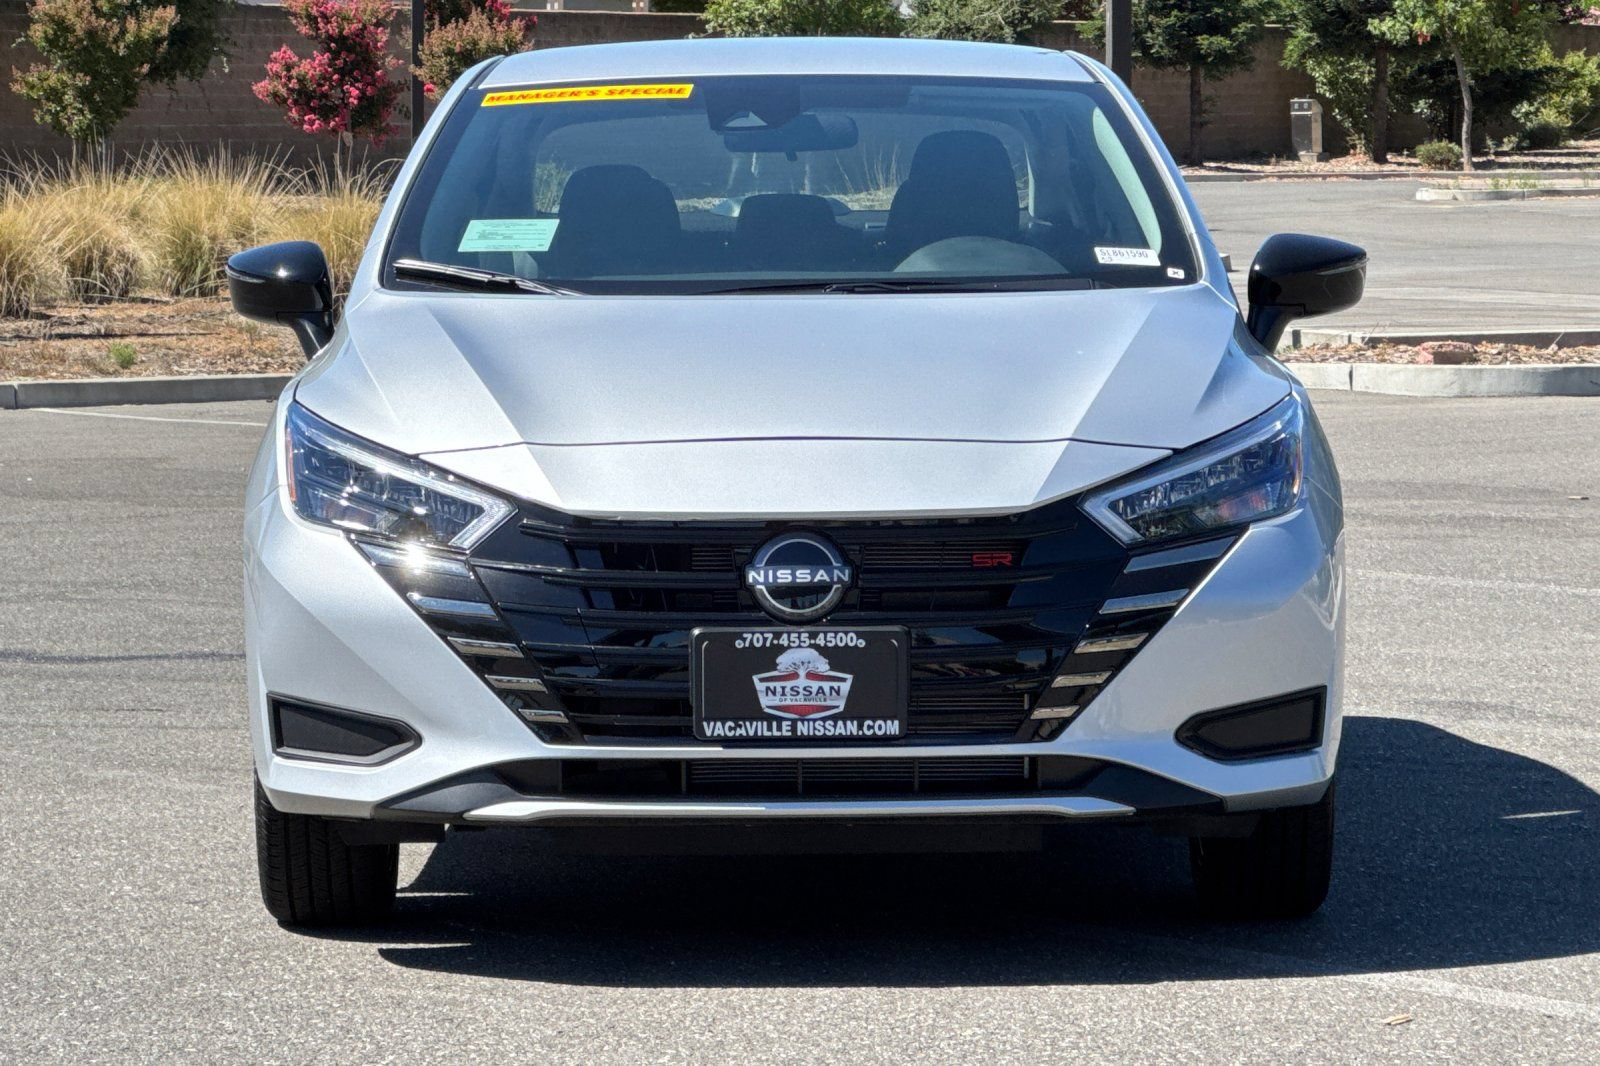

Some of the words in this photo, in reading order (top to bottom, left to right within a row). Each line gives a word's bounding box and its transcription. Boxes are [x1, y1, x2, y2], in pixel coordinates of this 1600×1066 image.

[486, 89, 600, 102] MANAGER'S
[604, 86, 687, 97] SPECIAL
[972, 552, 1012, 566] SR
[748, 569, 848, 583] NISSAN
[743, 633, 857, 647] 707-455-4500
[765, 685, 841, 697] NISSAN
[703, 721, 792, 737] VACAVILLE
[797, 720, 899, 736] NISSAN.COM
